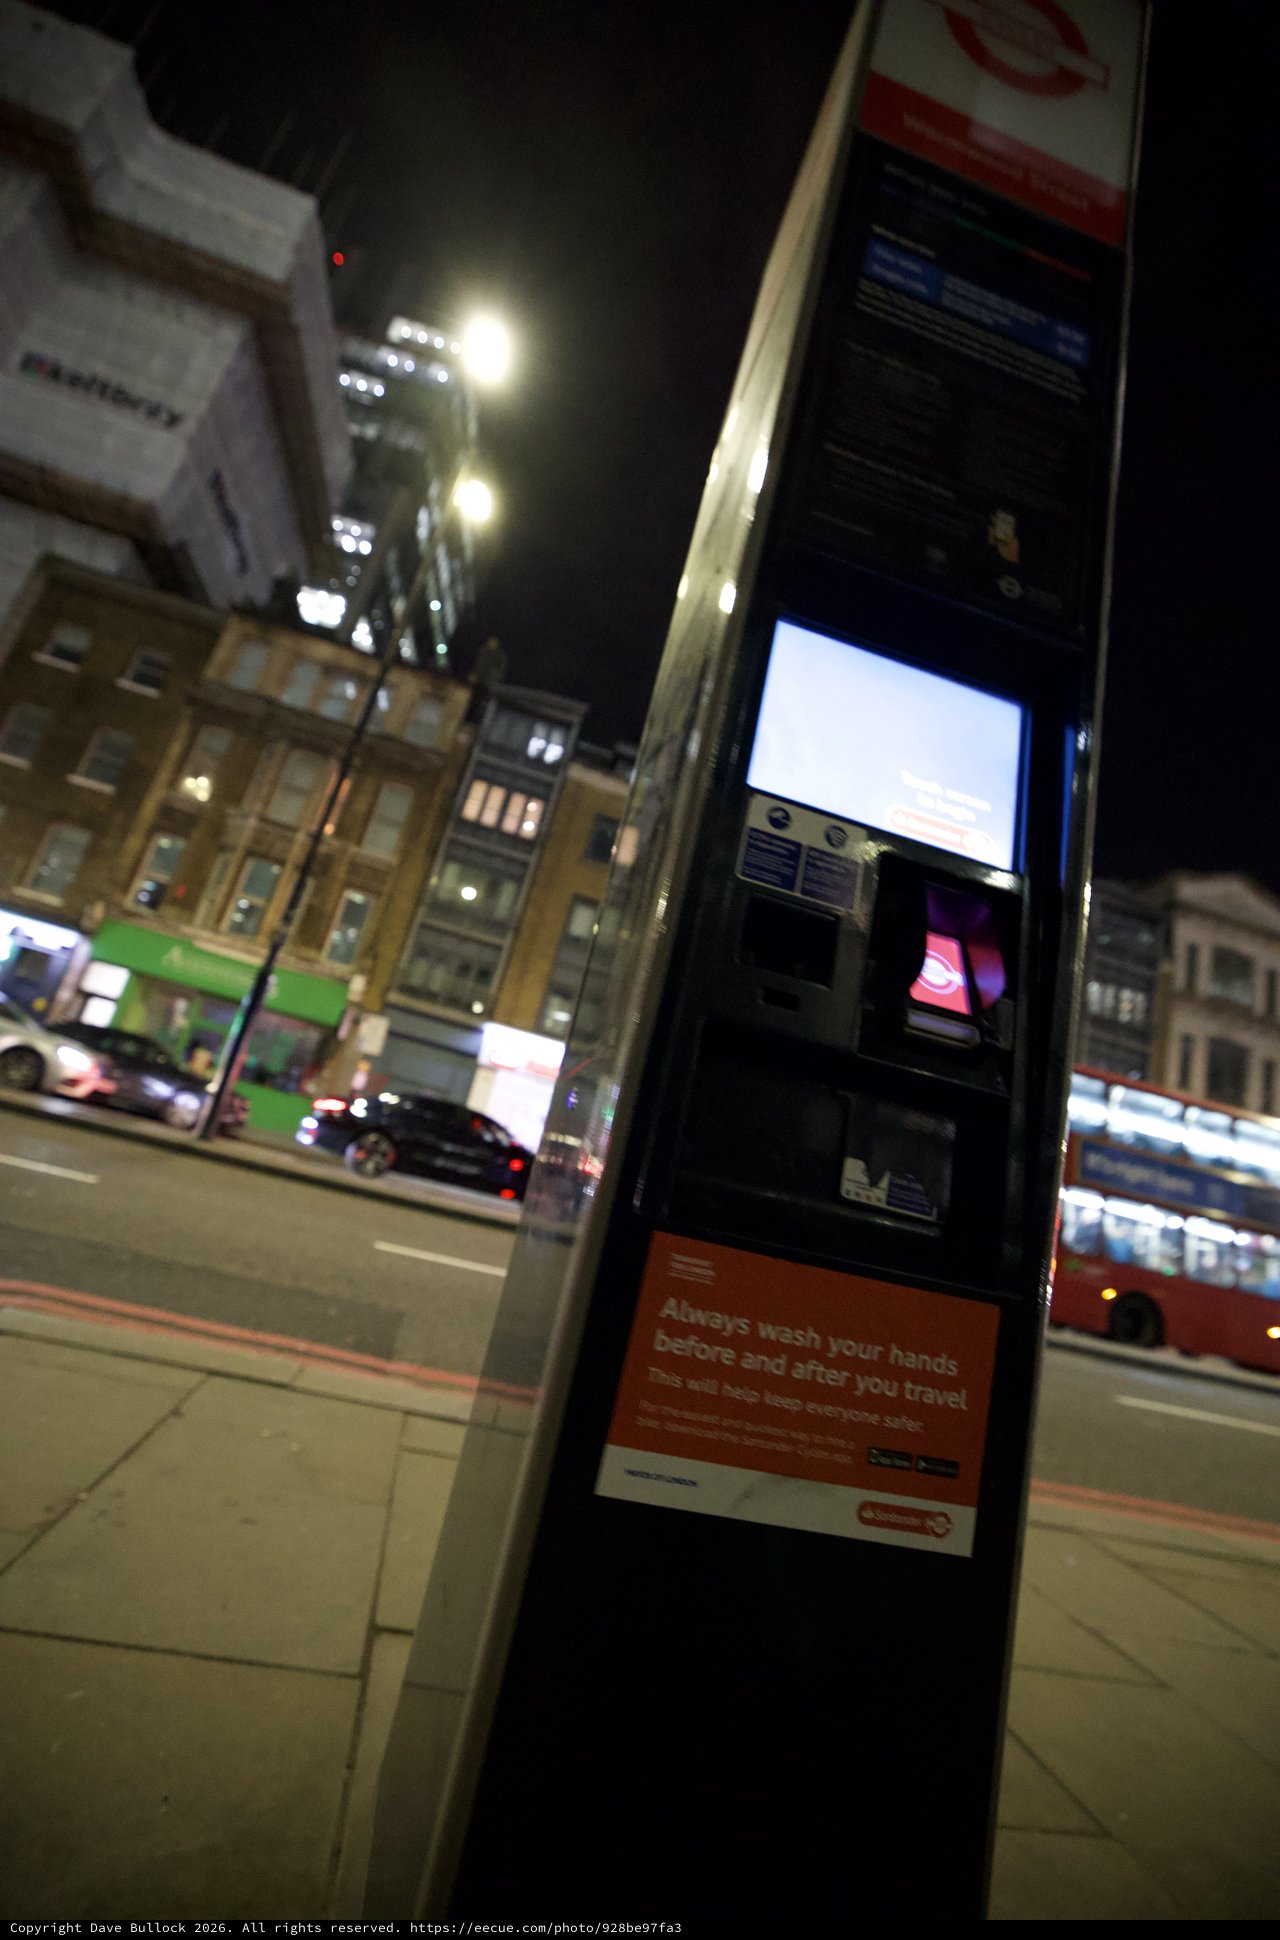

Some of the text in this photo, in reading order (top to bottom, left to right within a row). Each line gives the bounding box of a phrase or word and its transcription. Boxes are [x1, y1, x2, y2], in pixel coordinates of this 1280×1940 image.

[653, 1329, 969, 1411] before and after you travel
[659, 1296, 959, 1377] Always wash your hands
[647, 1366, 925, 1434] This will help keep everyone safer.
